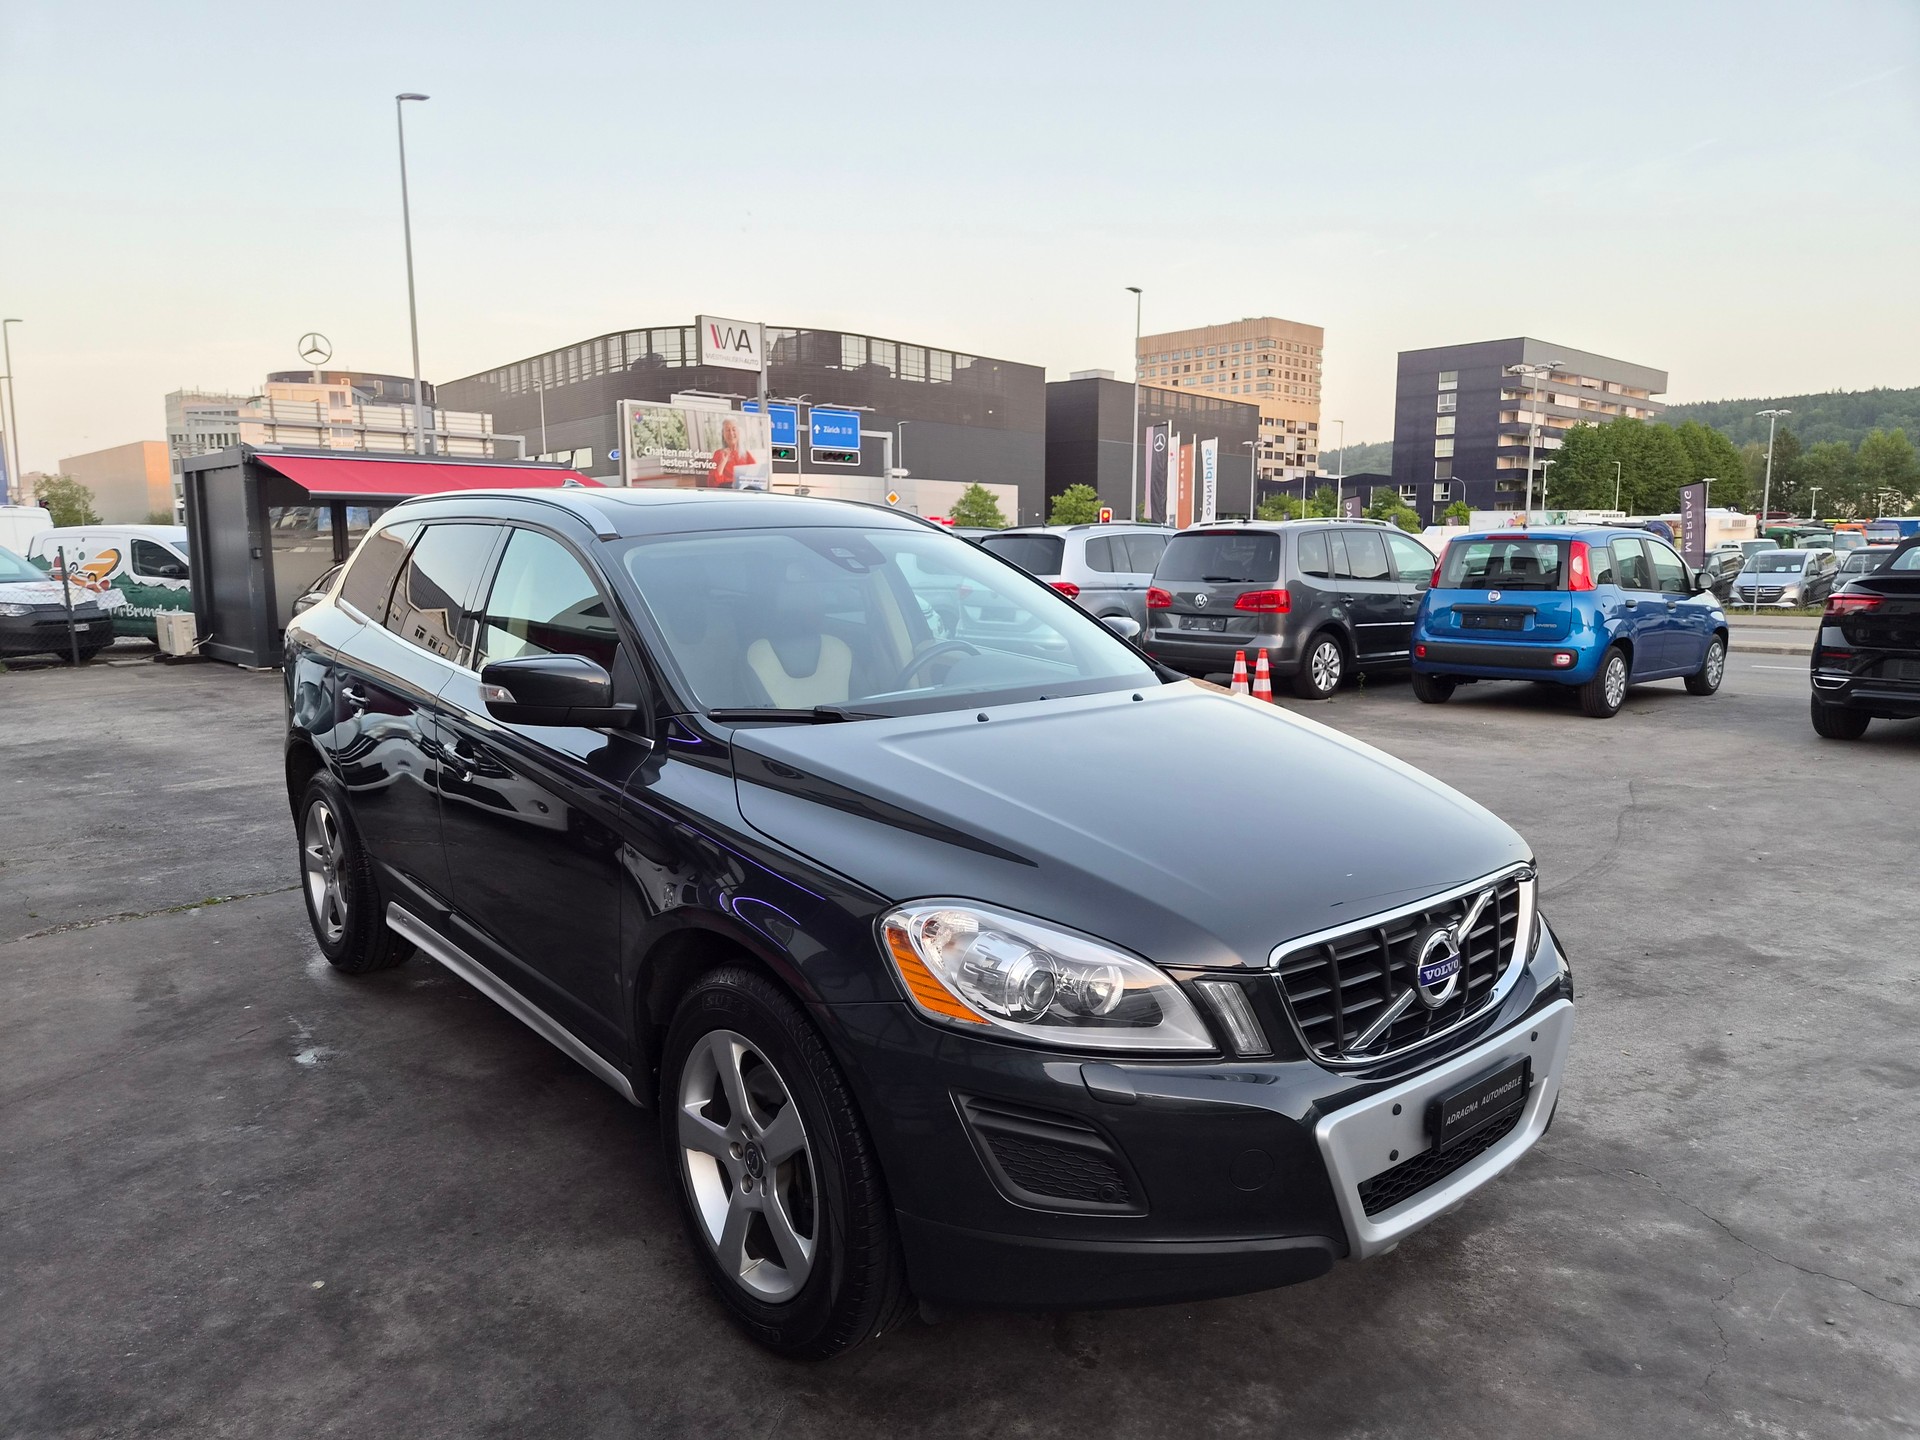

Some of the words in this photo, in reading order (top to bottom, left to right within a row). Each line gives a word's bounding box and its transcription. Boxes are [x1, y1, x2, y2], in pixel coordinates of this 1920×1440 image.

[644, 446, 677, 456] Chatten
[678, 449, 693, 458] mit
[694, 450, 714, 459] dem
[660, 457, 688, 467] besten
[689, 459, 717, 469] Service
[1424, 959, 1458, 980] VOLVO
[1446, 1101, 1478, 1126] ADRAGNA
[1481, 1075, 1522, 1106] AUTOMOBILE
